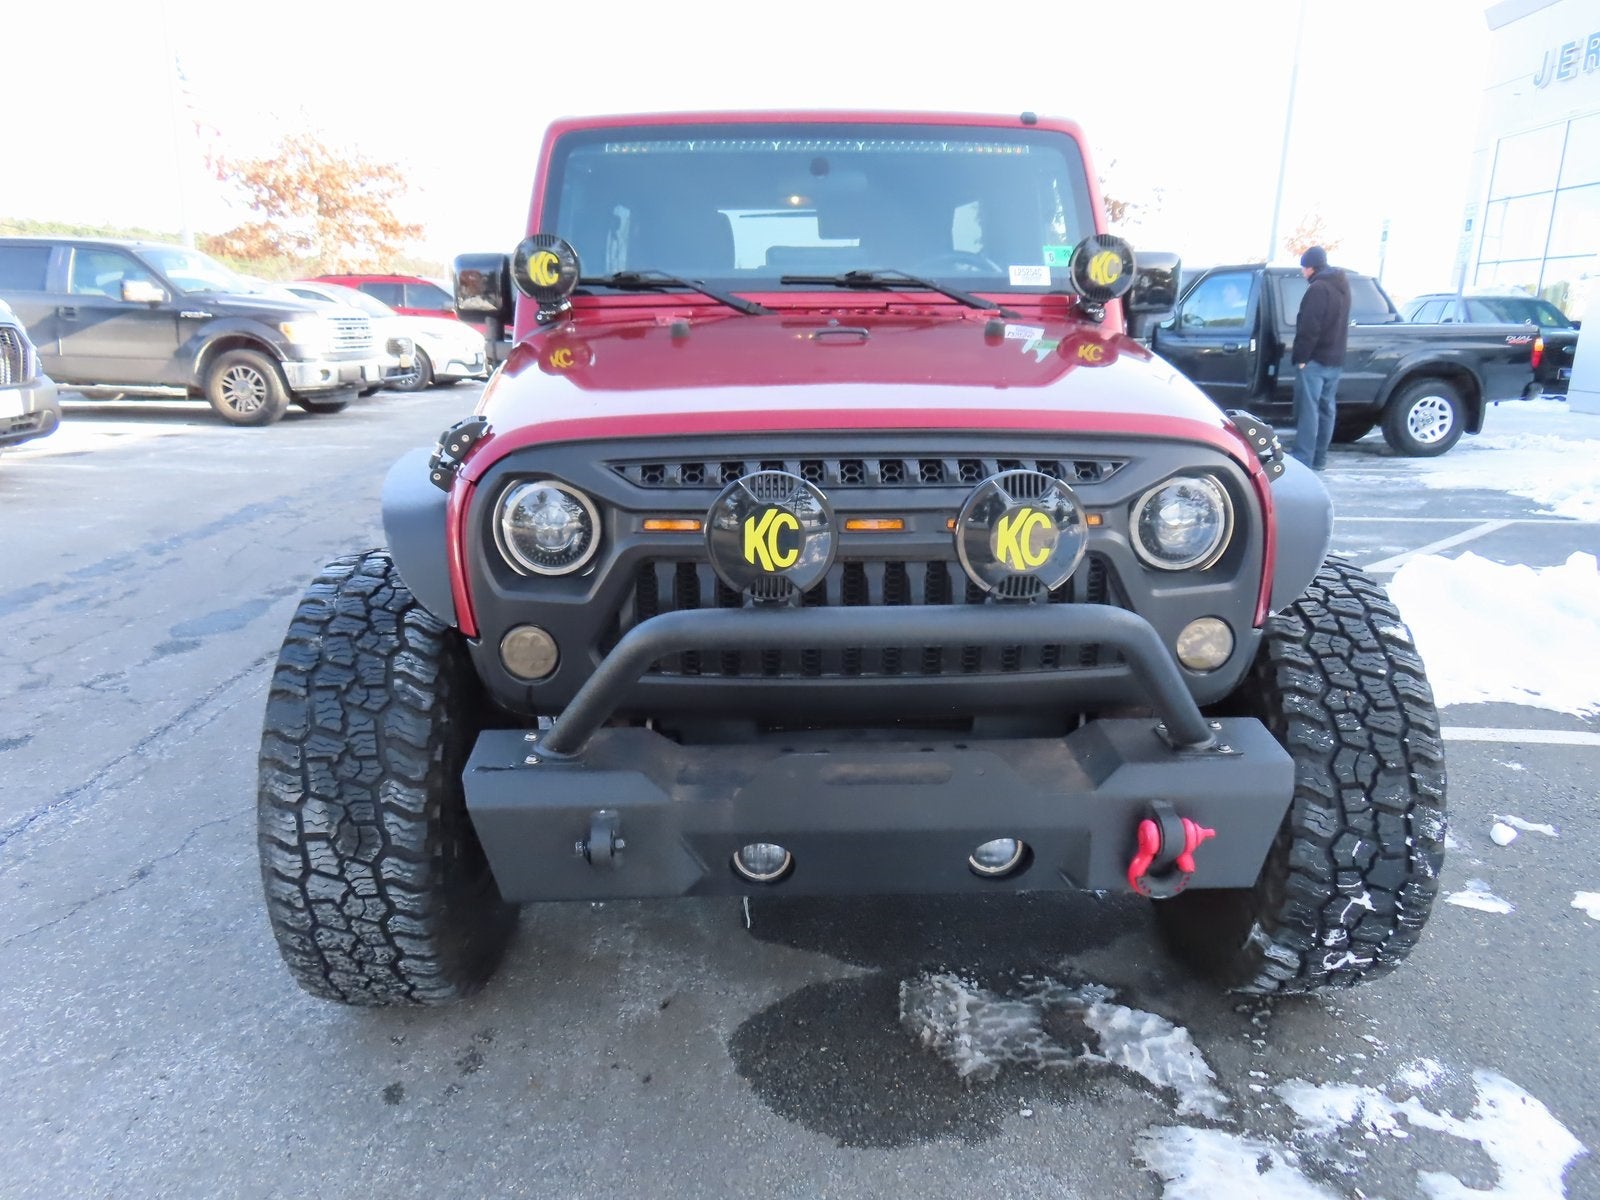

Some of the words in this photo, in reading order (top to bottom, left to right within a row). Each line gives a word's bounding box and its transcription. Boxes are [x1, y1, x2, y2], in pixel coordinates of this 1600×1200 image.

[528, 250, 559, 287] KC
[1090, 250, 1119, 286] KC
[744, 508, 799, 572] KC
[996, 507, 1052, 571] KC
